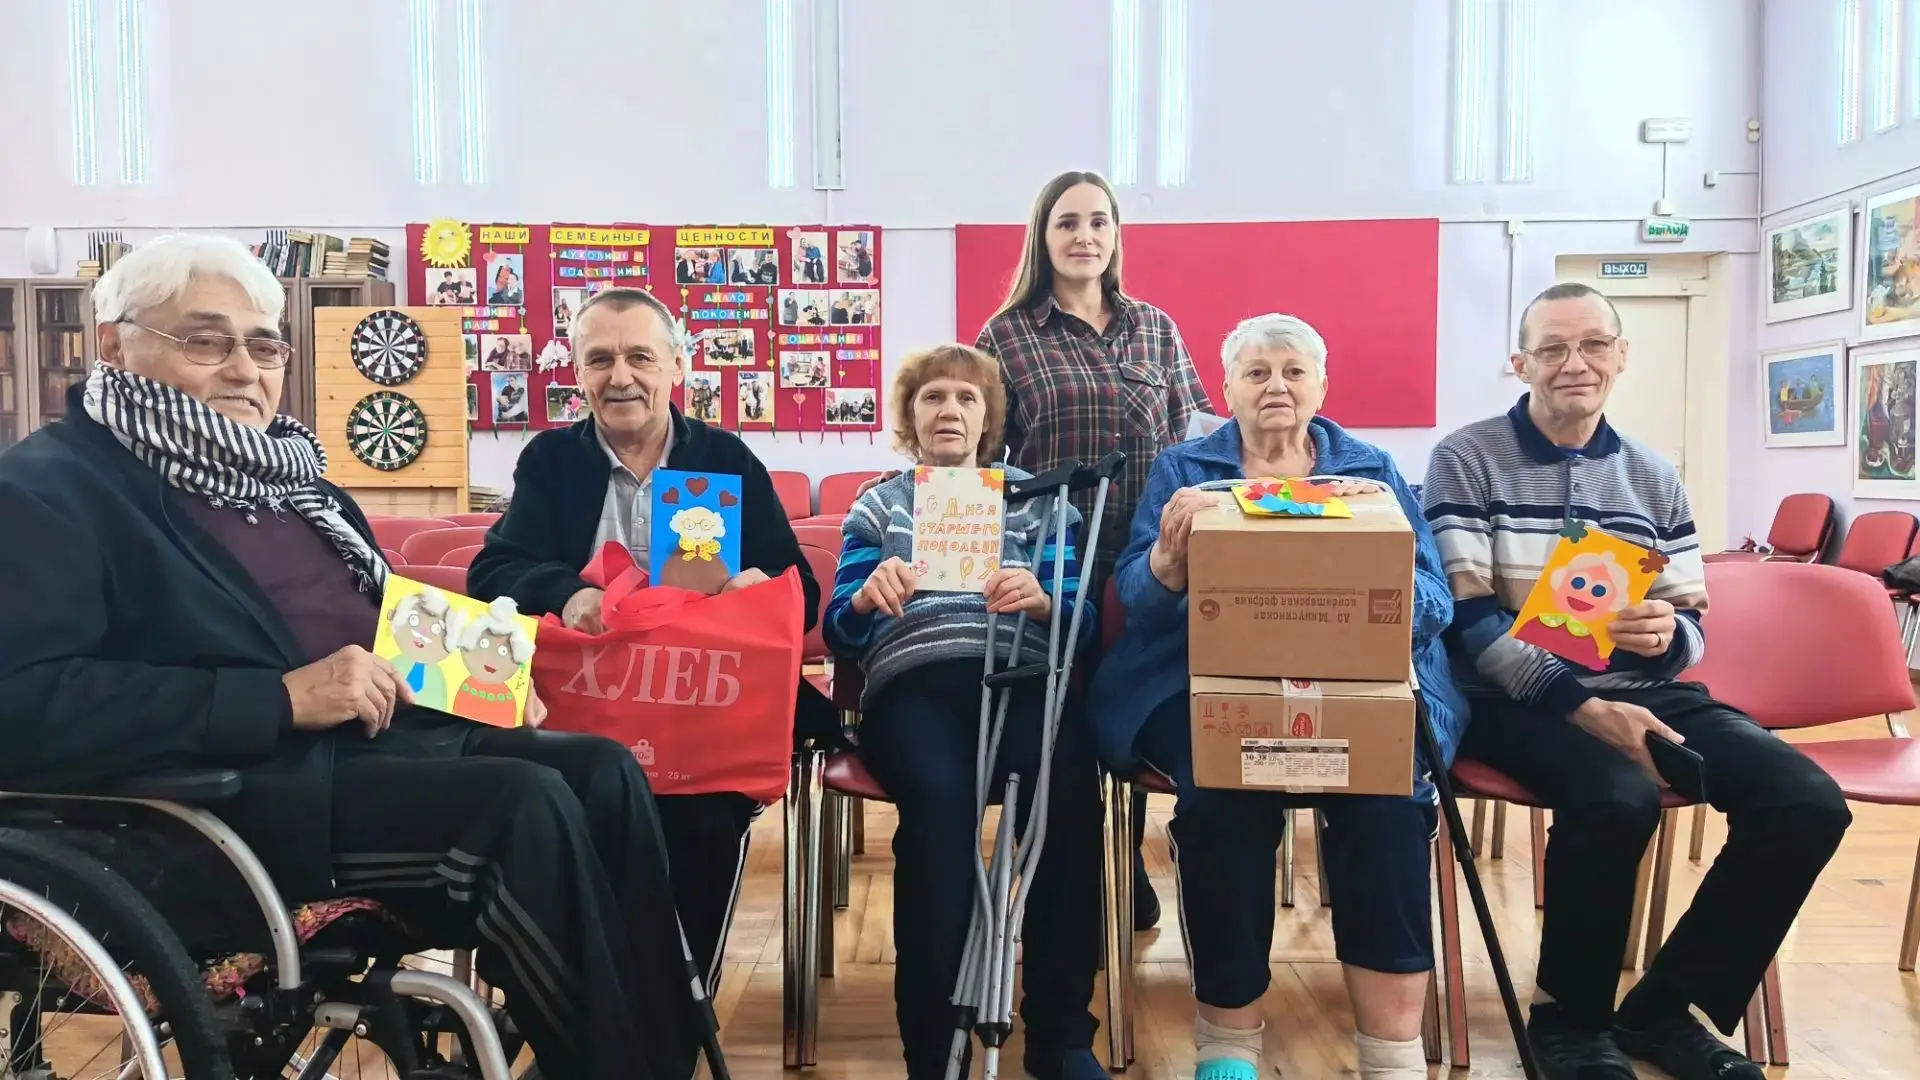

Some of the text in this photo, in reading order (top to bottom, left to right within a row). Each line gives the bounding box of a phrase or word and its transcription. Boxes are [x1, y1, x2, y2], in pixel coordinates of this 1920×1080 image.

[482, 230, 527, 240] НАШИ
[681, 231, 770, 242] ЦЕННОСТИ
[1604, 263, 1646, 275] ВЫХОД
[560, 642, 742, 707] ХЛЕБ
